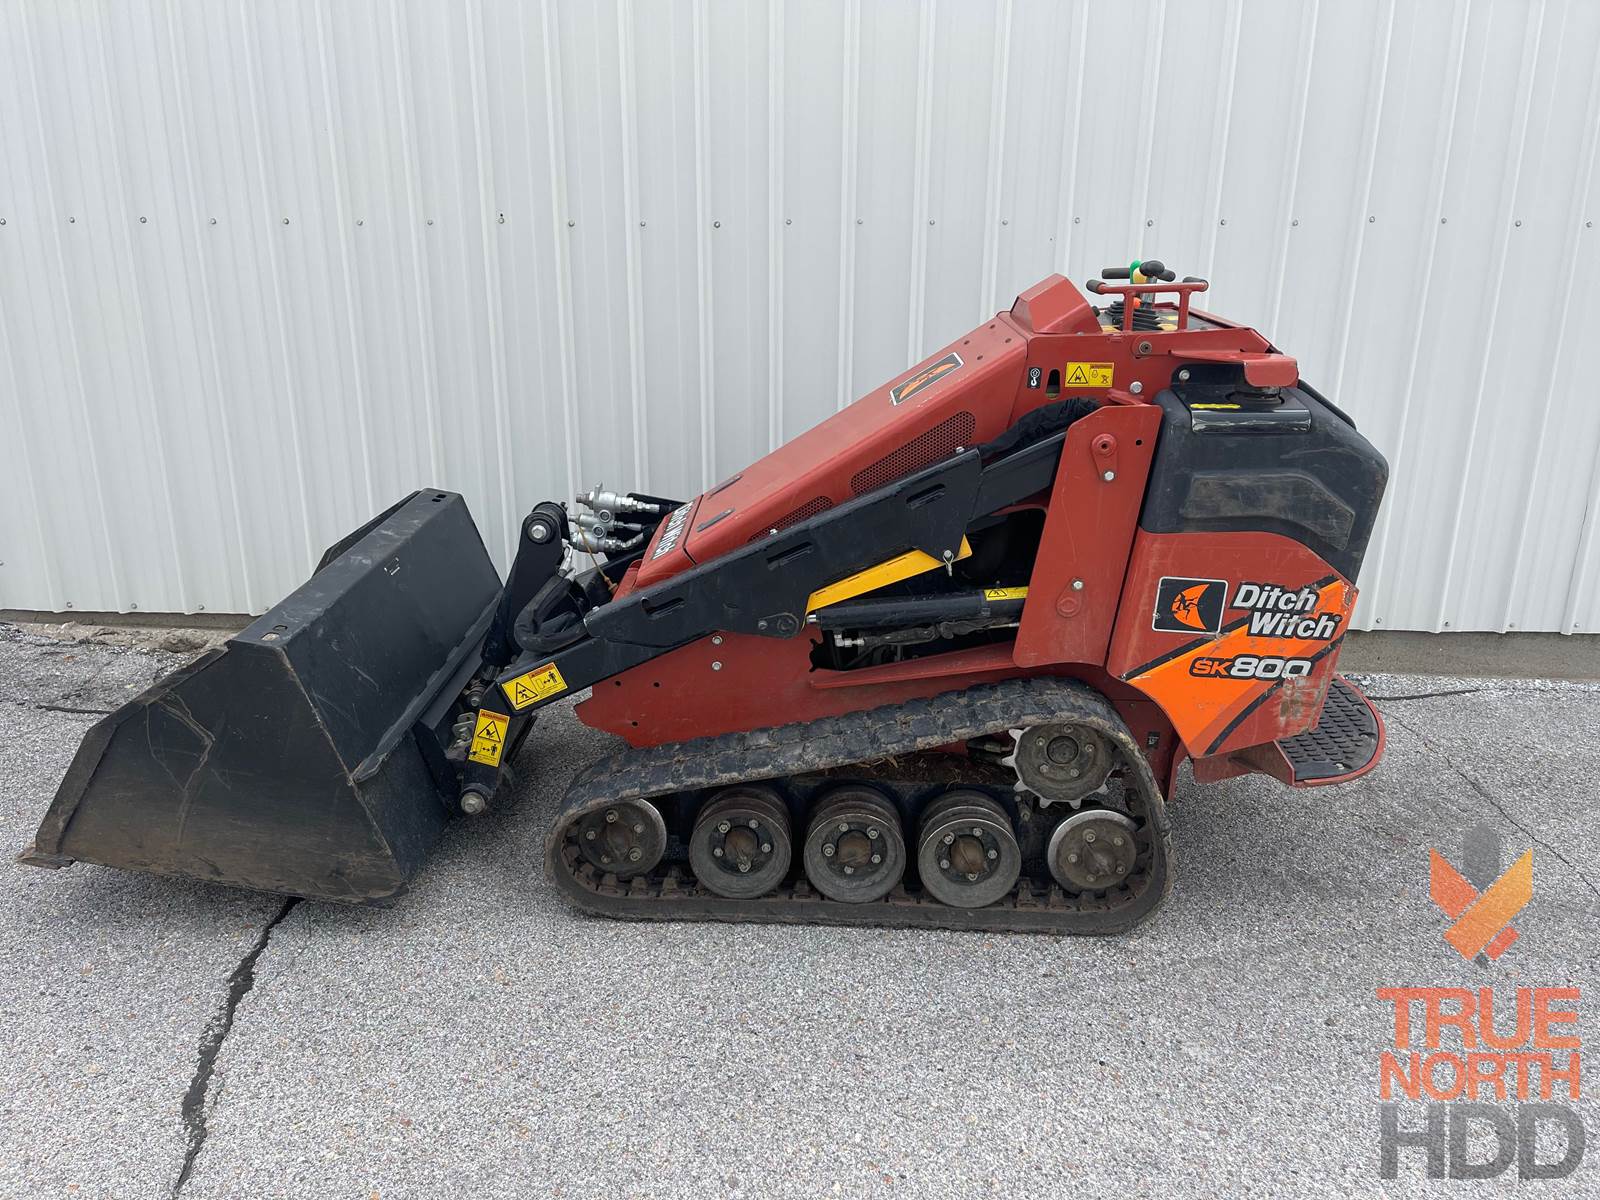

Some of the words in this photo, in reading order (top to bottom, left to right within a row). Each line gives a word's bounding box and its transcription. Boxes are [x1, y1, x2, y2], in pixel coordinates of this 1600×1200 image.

[1233, 584, 1318, 611] Ditch
[1249, 611, 1337, 640] Witch
[1193, 657, 1312, 679] SK800
